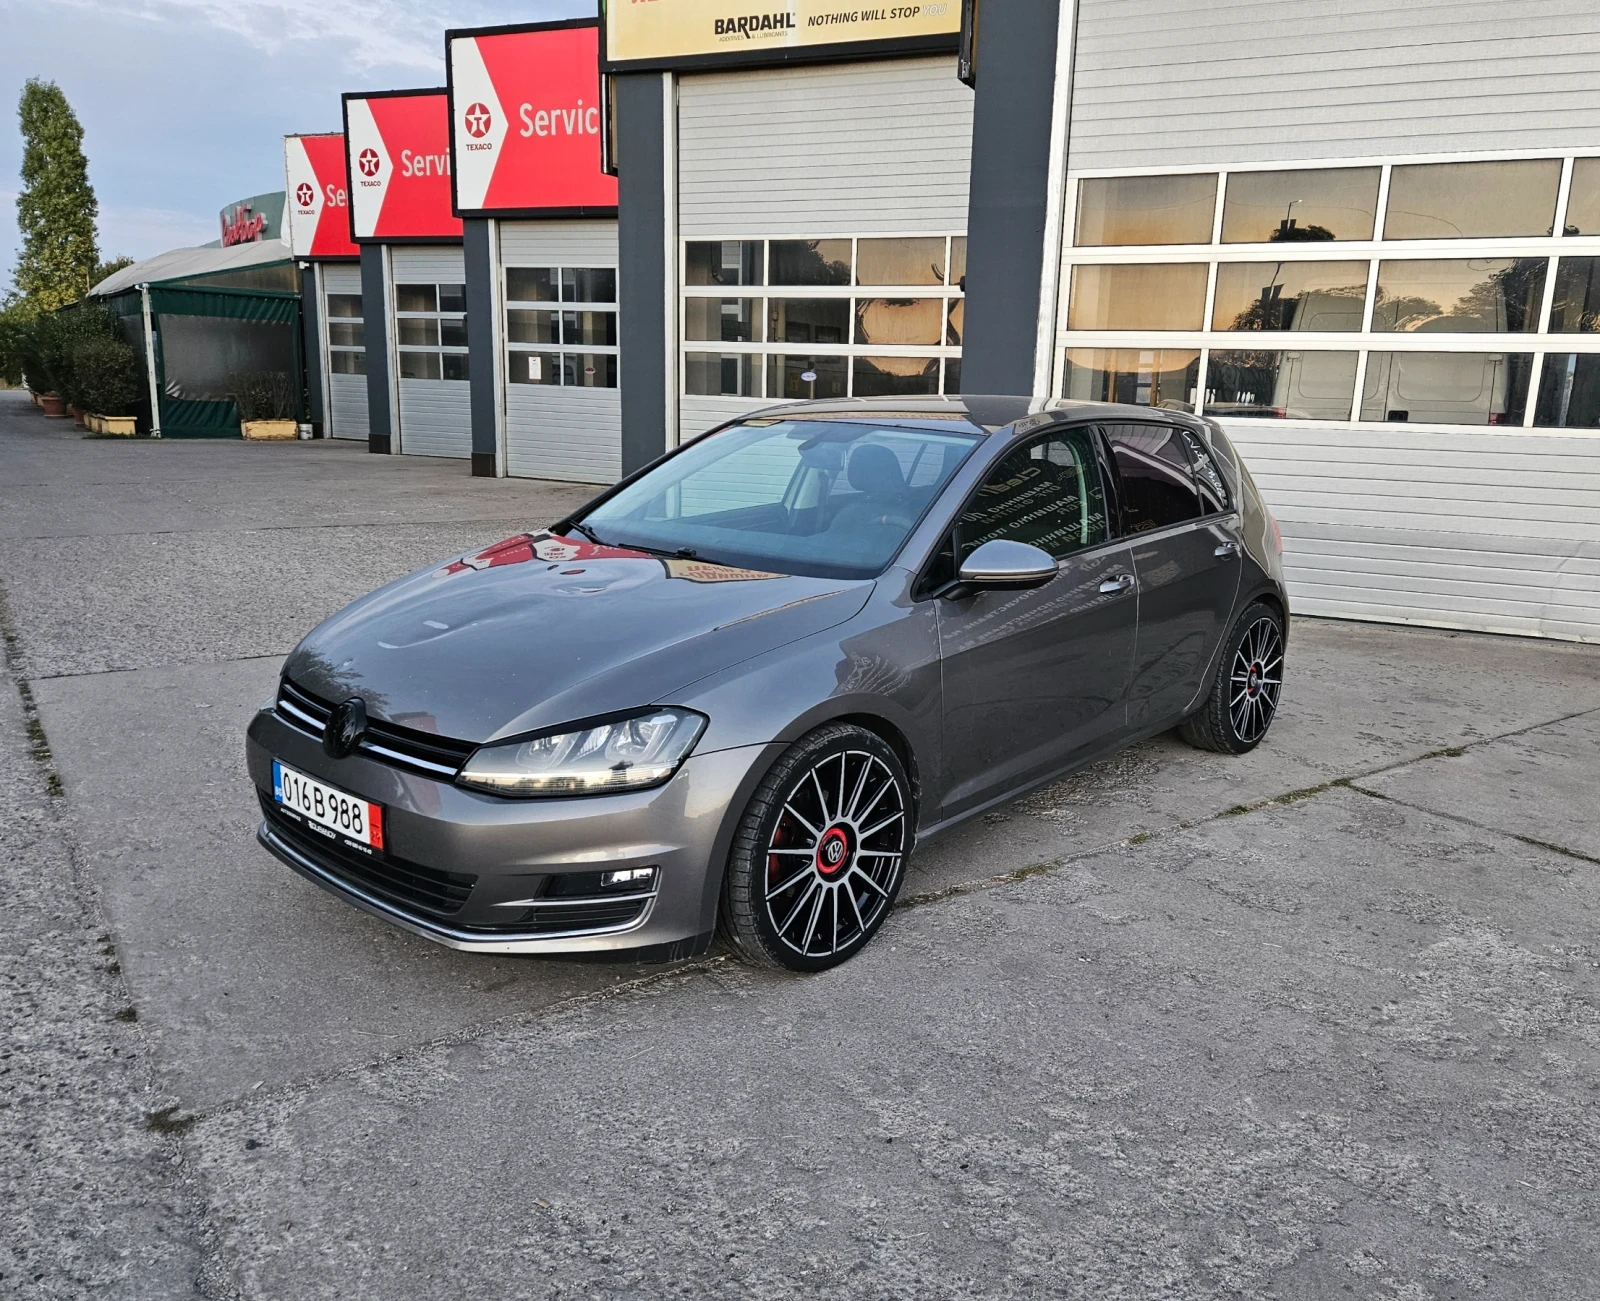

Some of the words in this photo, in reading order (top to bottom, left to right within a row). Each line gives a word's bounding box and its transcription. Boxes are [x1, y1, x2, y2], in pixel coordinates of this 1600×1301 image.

[714, 12, 796, 39] BARDAHL
[807, 11, 858, 27] NOTHING
[861, 9, 887, 21] WILL
[890, 6, 920, 19] STOP
[922, 3, 948, 16] YOU
[757, 31, 788, 39] LUBRICANTS
[519, 98, 599, 138] Servic
[466, 142, 493, 151] TEXACO
[326, 184, 349, 207] Se
[283, 772, 363, 834] 016B988
